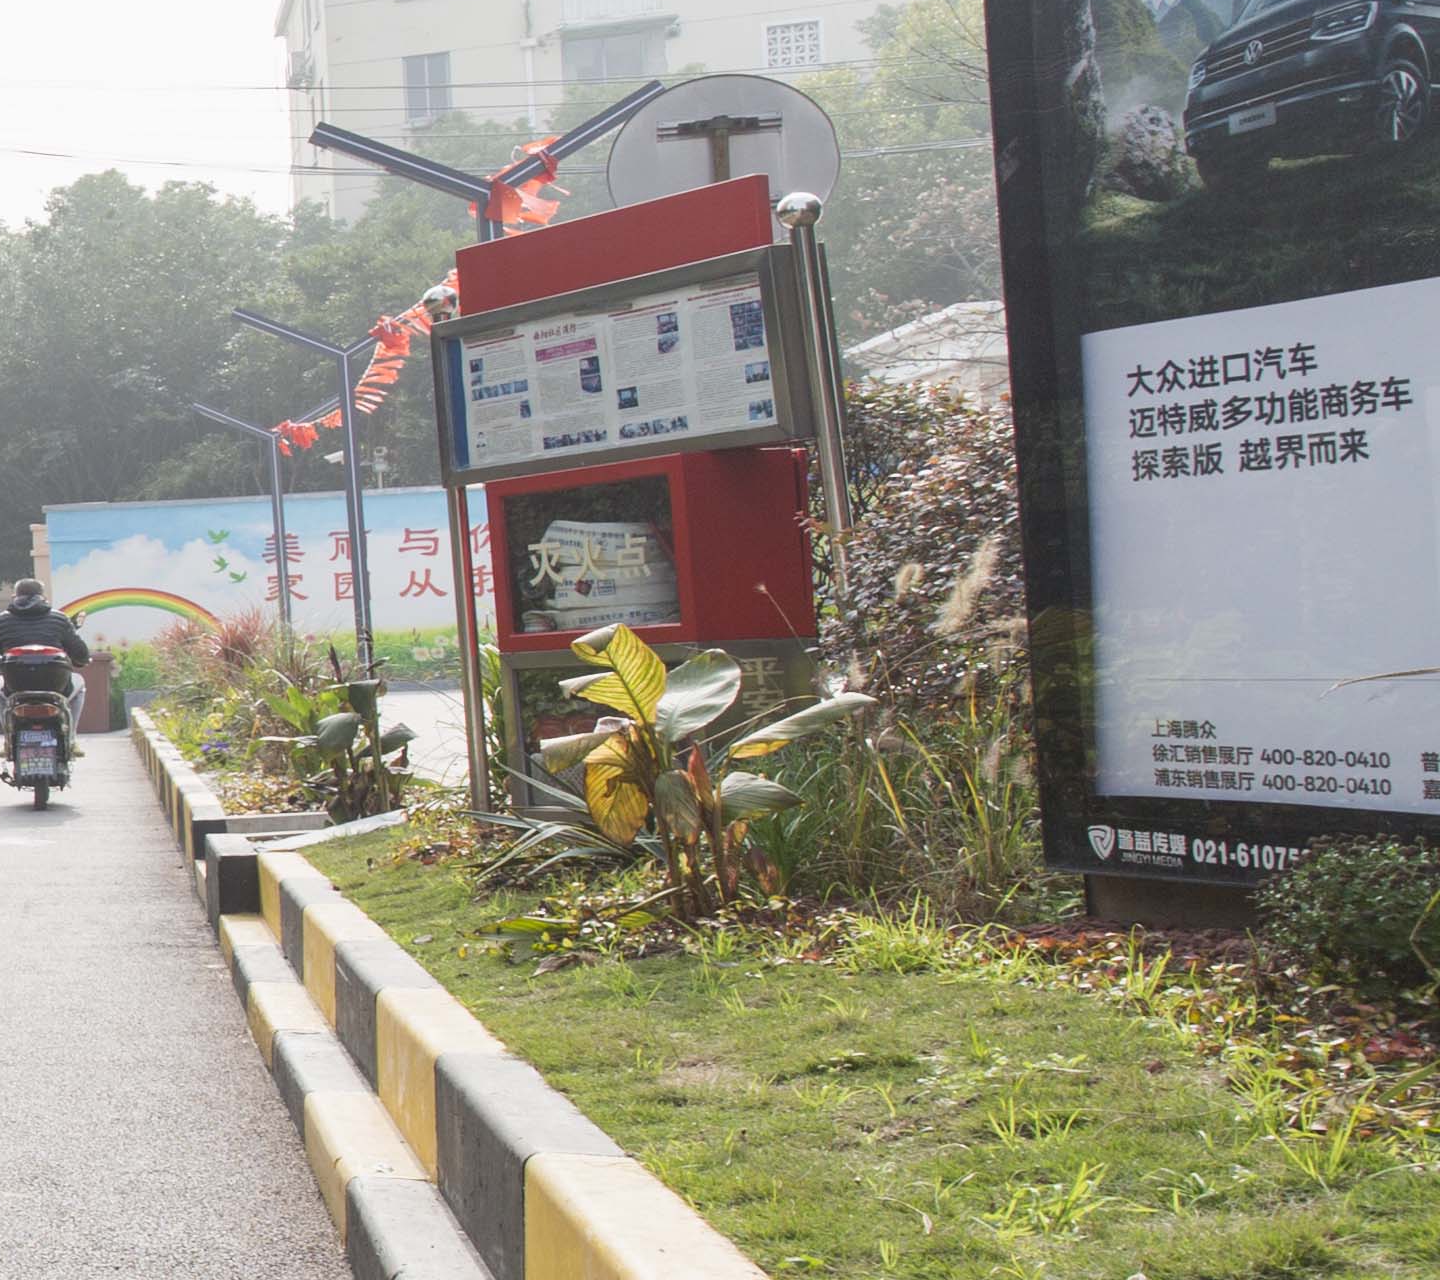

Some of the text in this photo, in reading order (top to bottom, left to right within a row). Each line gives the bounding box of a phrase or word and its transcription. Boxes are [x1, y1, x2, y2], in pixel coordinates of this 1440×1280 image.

[1127, 342, 1318, 398] 大众进口汽车
[1128, 376, 1414, 439] 迈特威多功能商务车
[1131, 427, 1370, 482] 探索版 越界而来
[527, 532, 652, 587] 灭火点
[1152, 743, 1391, 769] 徐汇销售展厅 400-820-0410
[1154, 768, 1392, 796] 浦东销售展厅 400-820-0410
[1192, 838, 1312, 870] 021-61075
